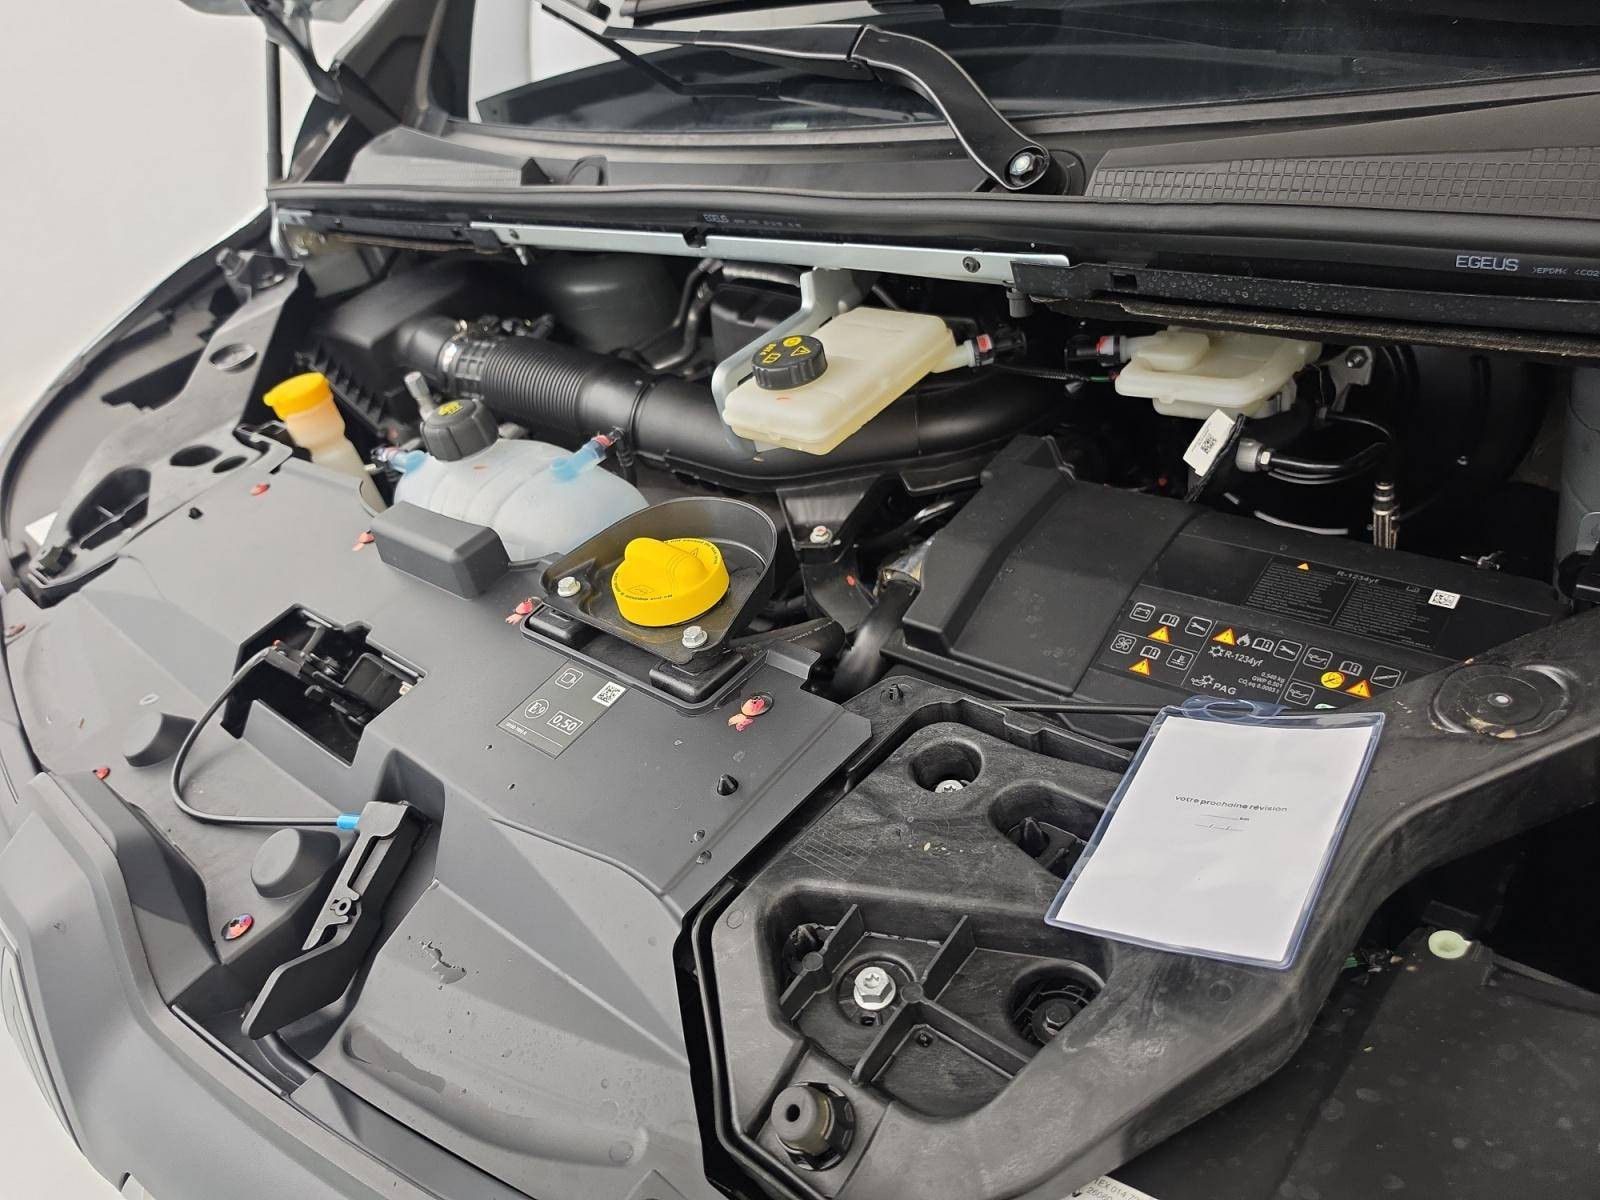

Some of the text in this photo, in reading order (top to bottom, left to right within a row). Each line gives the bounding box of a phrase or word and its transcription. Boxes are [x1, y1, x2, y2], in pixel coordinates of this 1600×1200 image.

[1455, 254, 1520, 272] EGEUS
[1223, 650, 1264, 667] R-1234yf
[1212, 682, 1238, 695] PAG
[552, 714, 578, 731] 0,50
[1175, 795, 1288, 812] votre prochaine révision
